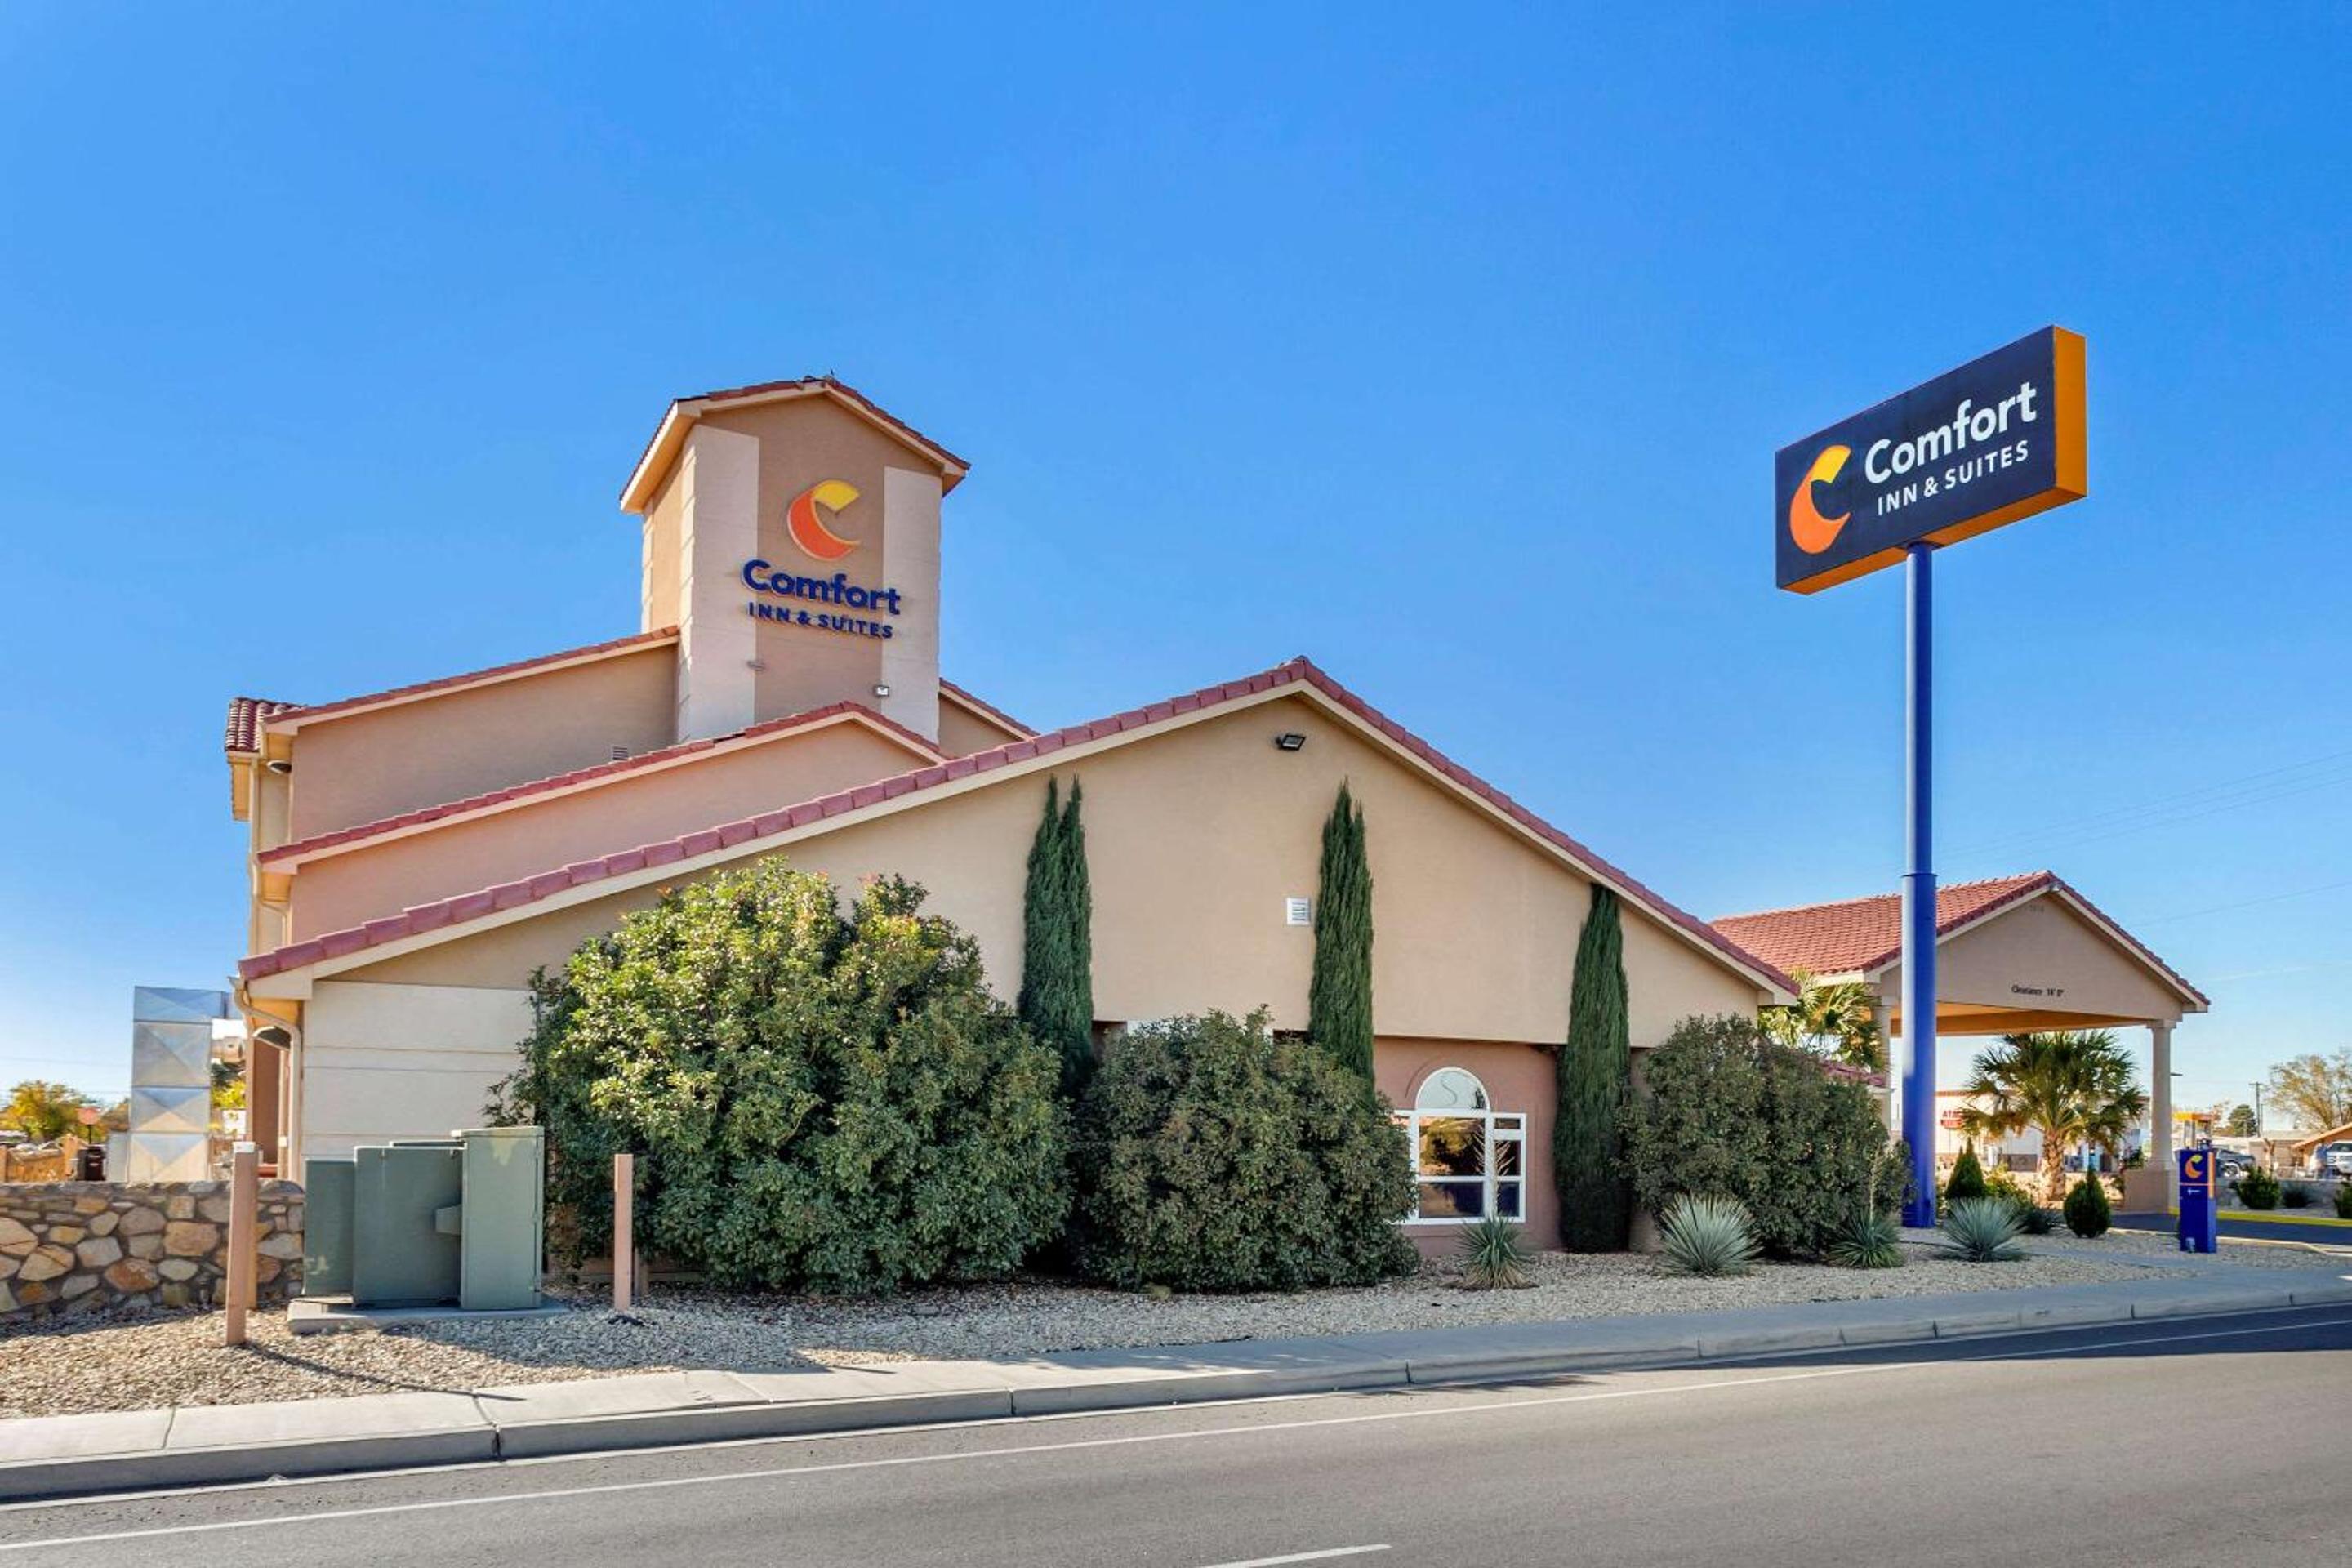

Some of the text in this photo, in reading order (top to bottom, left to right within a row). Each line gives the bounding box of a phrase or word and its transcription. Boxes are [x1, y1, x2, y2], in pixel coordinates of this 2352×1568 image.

[1865, 382, 2038, 484] Comfort
[1878, 439, 2029, 516] INN & SUITES
[742, 559, 902, 615] Comfort
[748, 602, 893, 639] INN & SUITES
